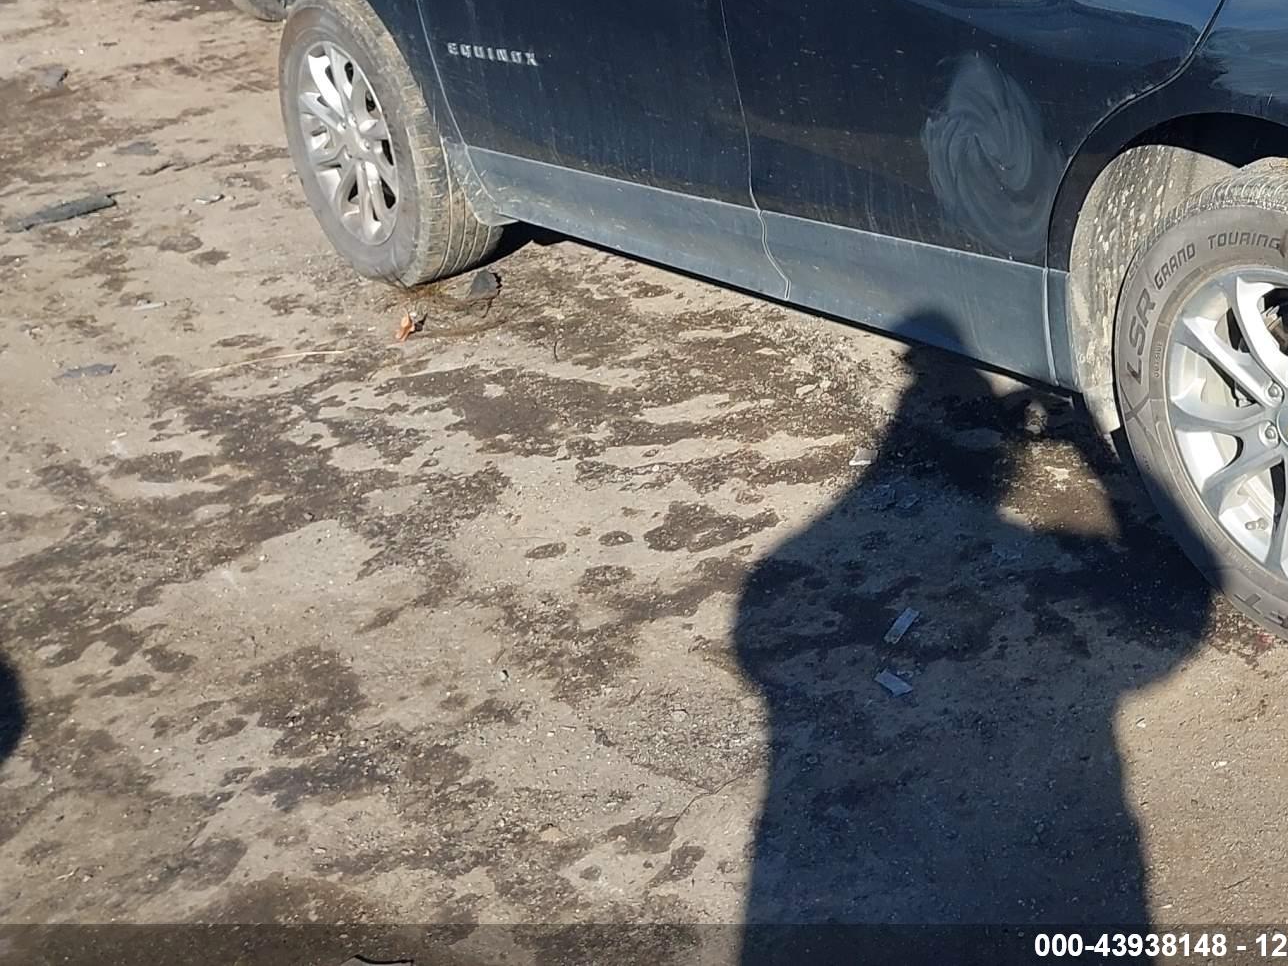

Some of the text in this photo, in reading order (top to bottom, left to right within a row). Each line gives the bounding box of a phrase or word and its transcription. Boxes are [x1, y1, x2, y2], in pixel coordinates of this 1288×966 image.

[447, 42, 539, 67] EQUINOX
[1126, 231, 1281, 385] LSR GRAND TOURING
